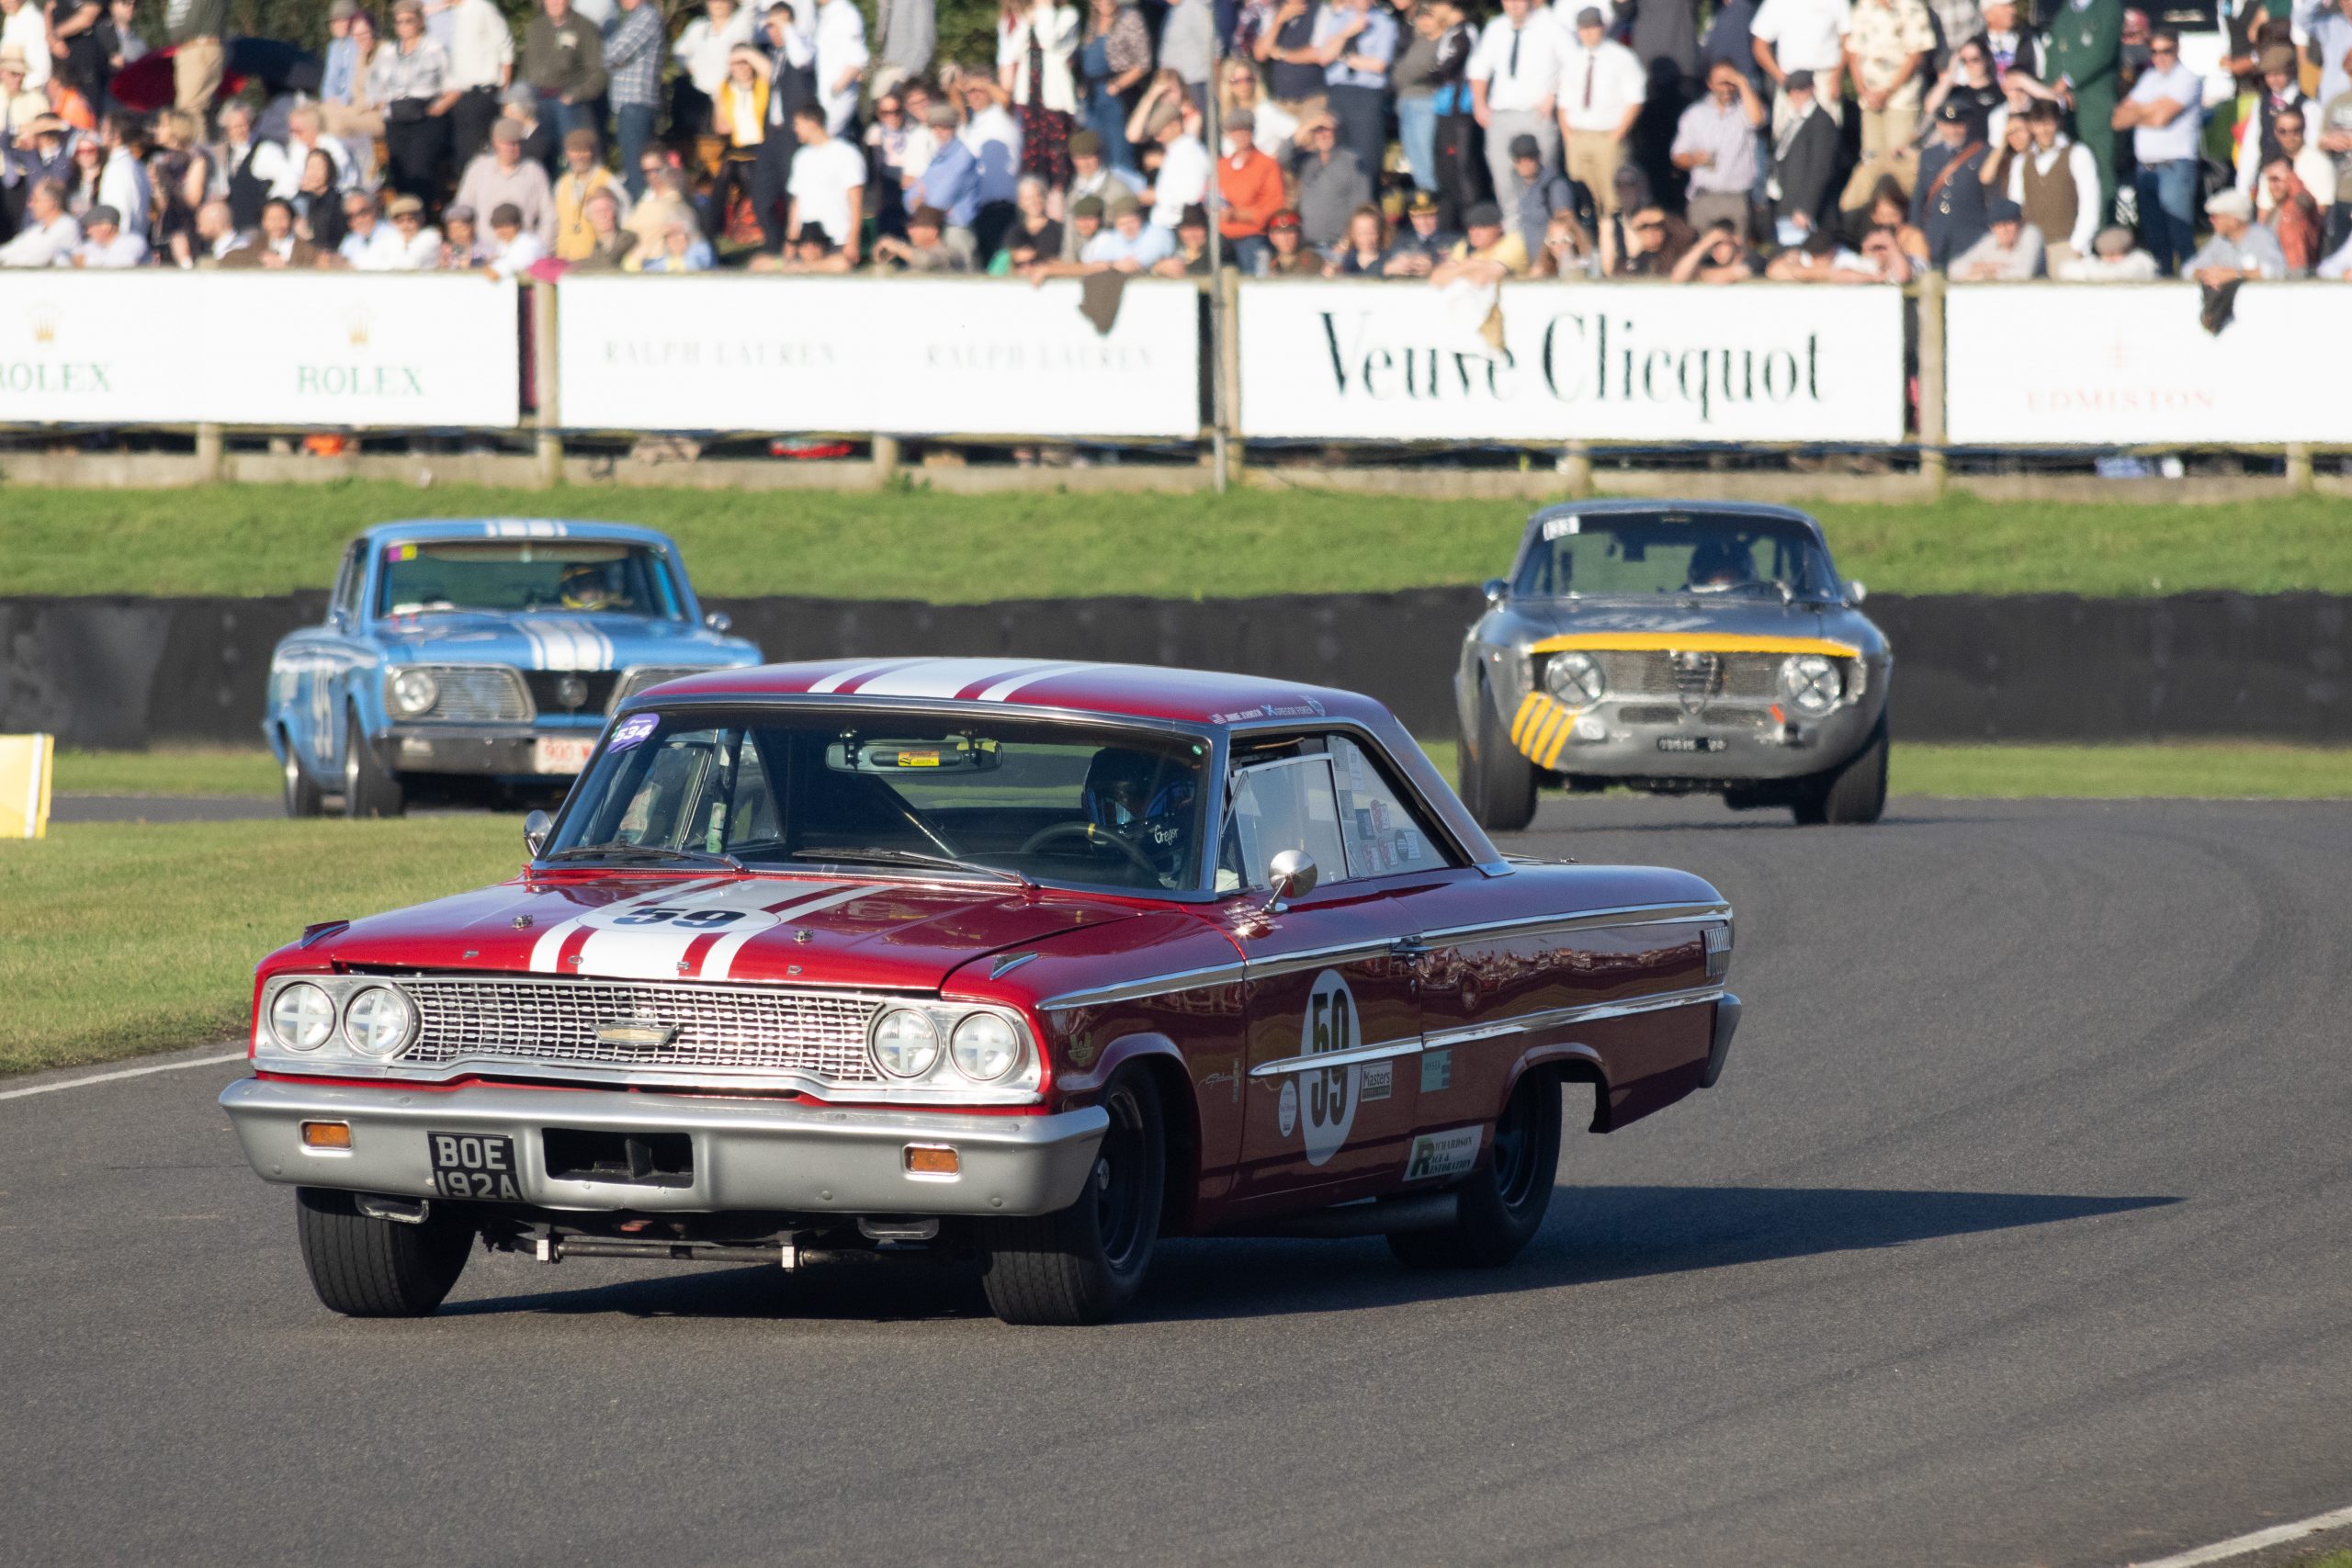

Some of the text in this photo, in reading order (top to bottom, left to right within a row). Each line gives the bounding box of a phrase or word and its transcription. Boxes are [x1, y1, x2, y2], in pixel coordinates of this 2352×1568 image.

[605, 340, 702, 366] RALPH
[1319, 310, 1824, 423] Veuve Clicquot
[0, 363, 112, 392] OLEX
[296, 366, 424, 396] ROLEX
[2026, 389, 2217, 413] EDMISTON
[612, 724, 654, 743] 534
[1154, 824, 1180, 846] Gregor
[613, 908, 747, 929] 59
[1311, 988, 1350, 1128] 59
[1363, 1070, 1391, 1088] Masters
[435, 1135, 507, 1170] BOE
[436, 1171, 521, 1199] 192A
